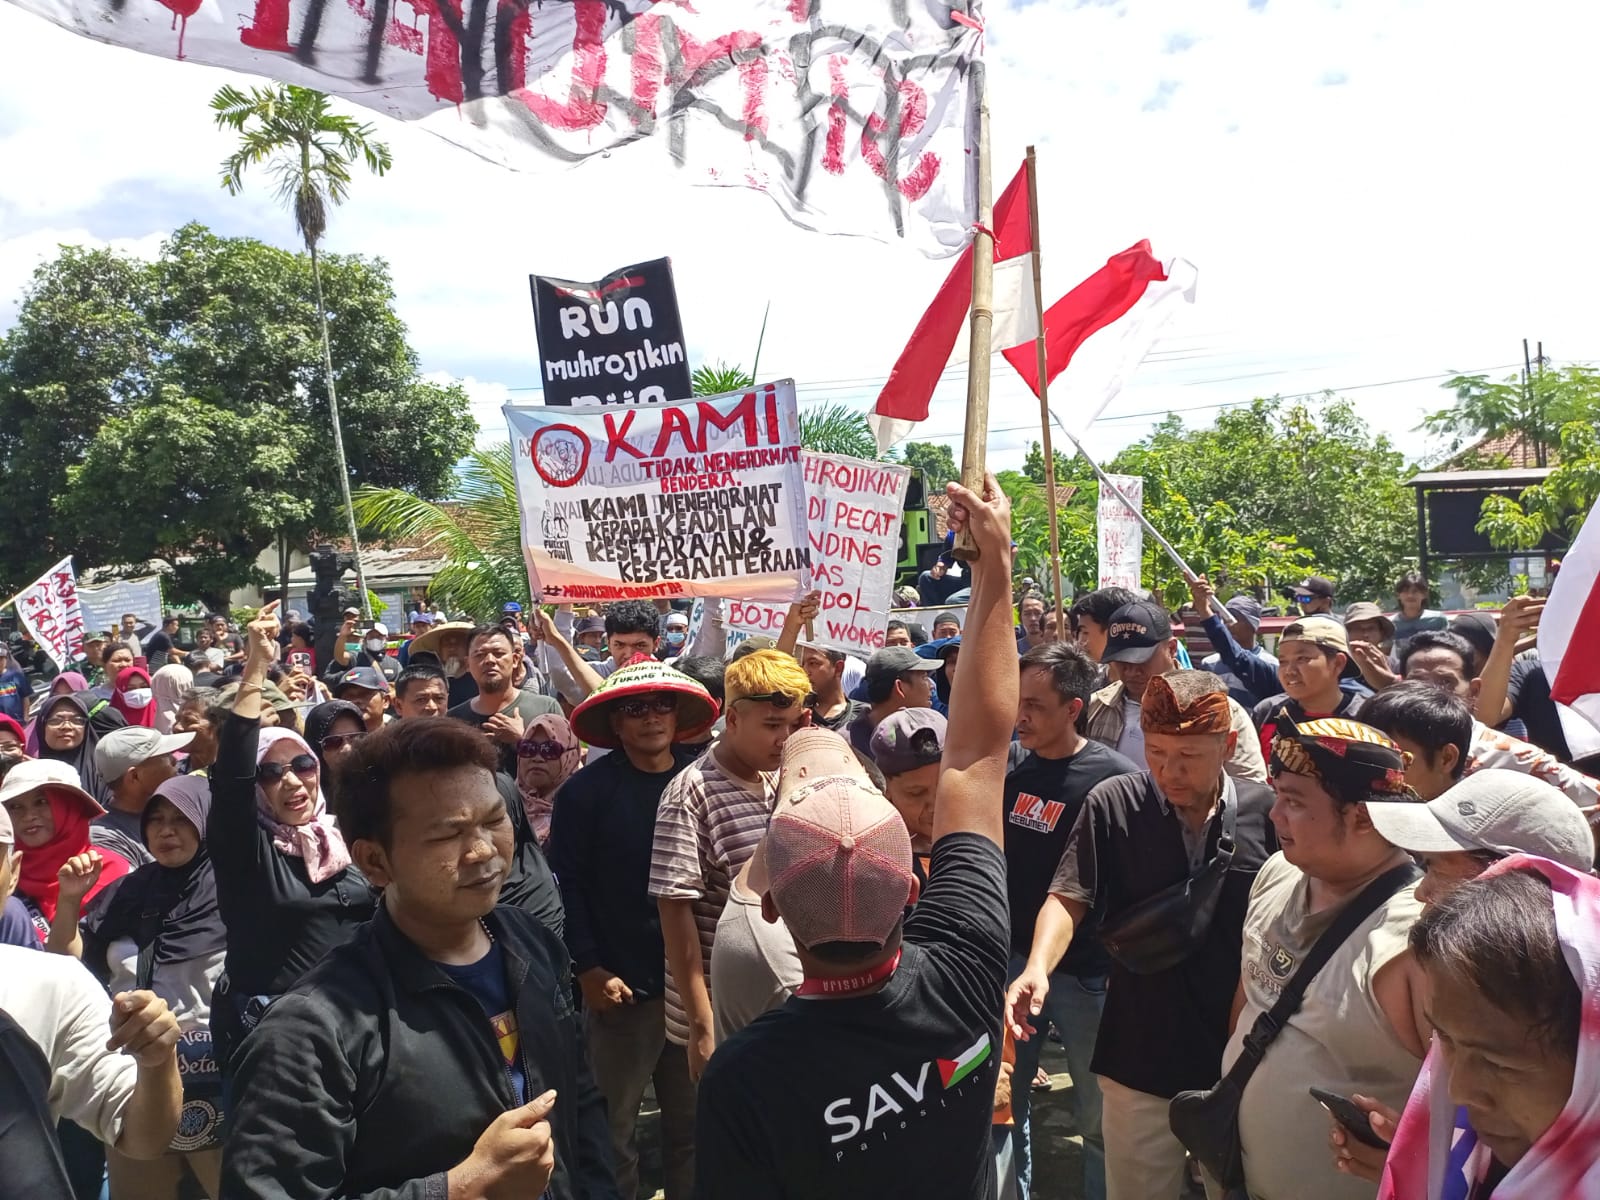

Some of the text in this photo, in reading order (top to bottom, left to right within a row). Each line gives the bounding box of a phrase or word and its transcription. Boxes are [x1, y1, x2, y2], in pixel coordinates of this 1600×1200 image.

[559, 297, 653, 340] RUN
[801, 455, 899, 496] HROJIKIN
[581, 492, 648, 522] KAMI
[834, 501, 897, 537] PECAT
[617, 547, 811, 584] KESEJAHTERAAN
[1275, 948, 1292, 970] 87
[822, 972, 873, 992] PERSIJA
